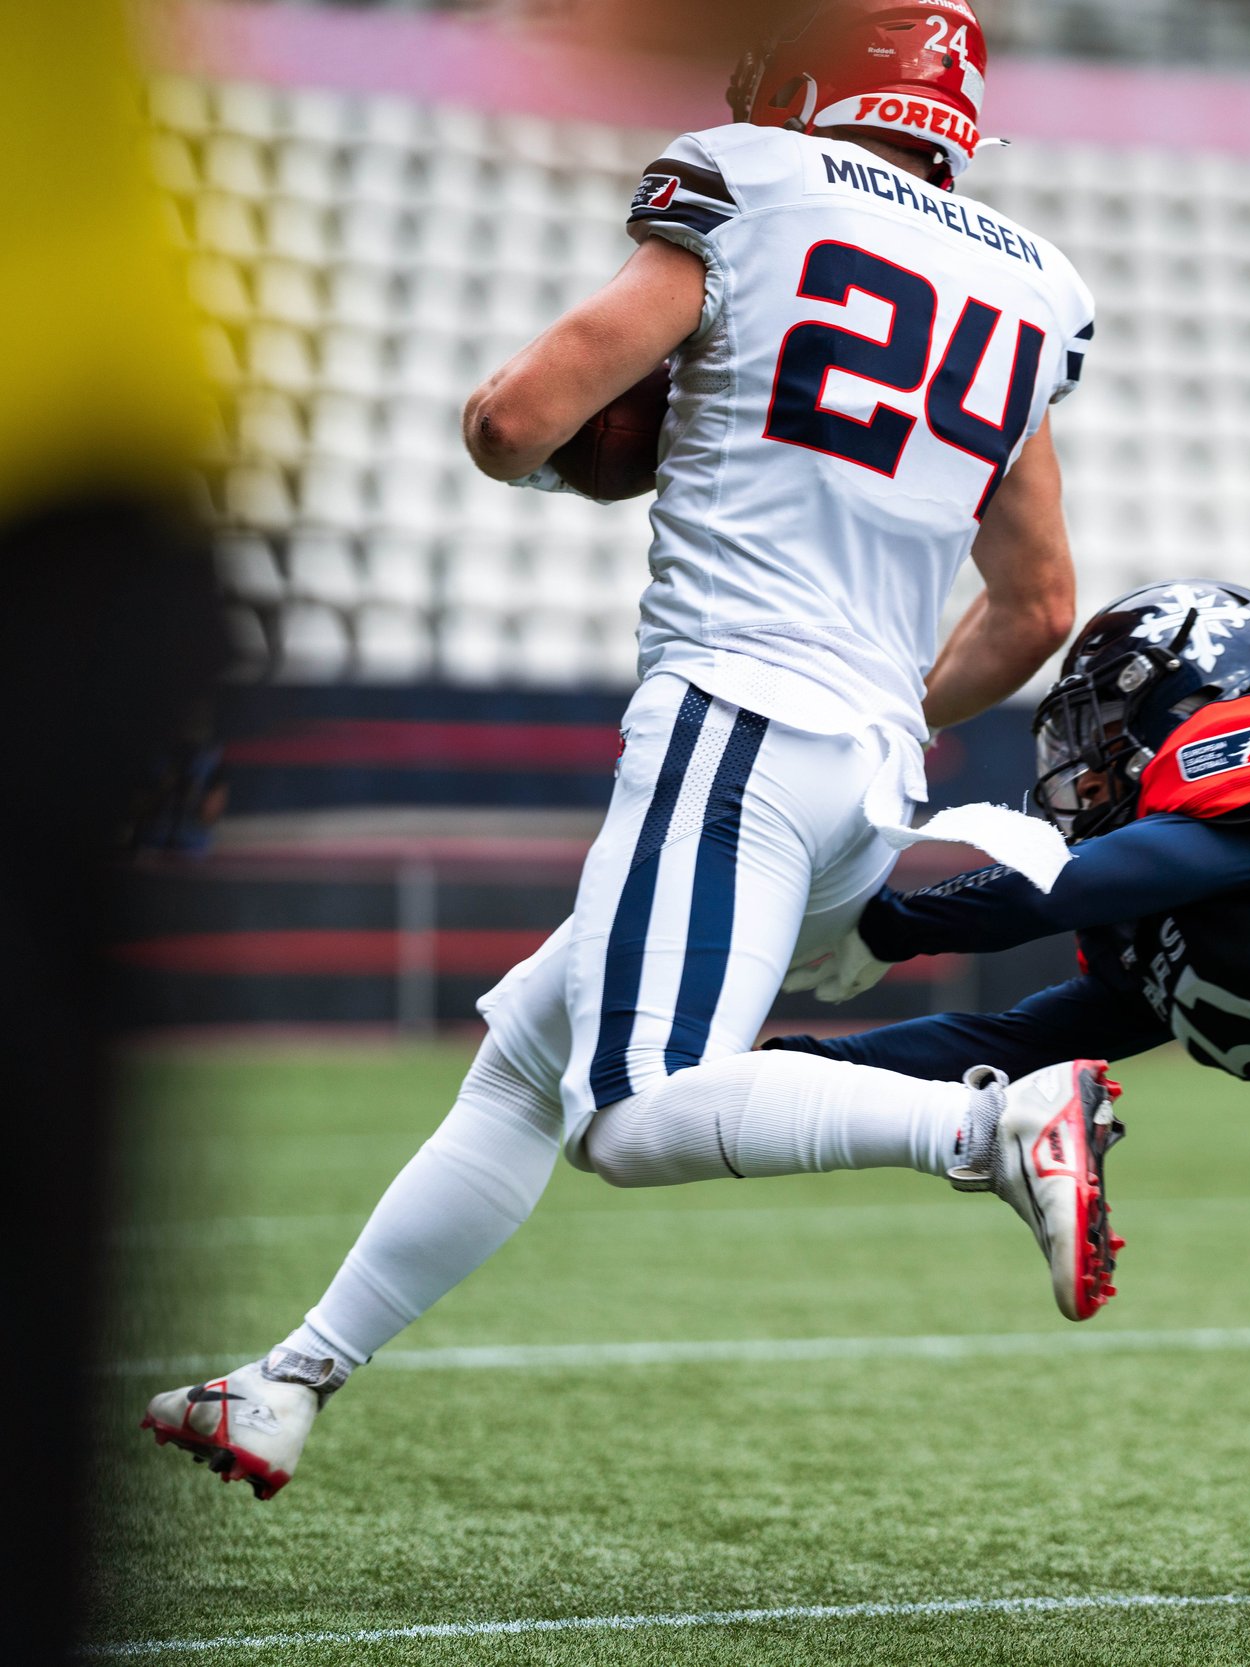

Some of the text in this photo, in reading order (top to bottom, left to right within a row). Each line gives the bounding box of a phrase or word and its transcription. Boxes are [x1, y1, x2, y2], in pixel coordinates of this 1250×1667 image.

[923, 14, 969, 69] 24
[821, 152, 1044, 271] MICHAELSEN
[761, 238, 1047, 525] 24
